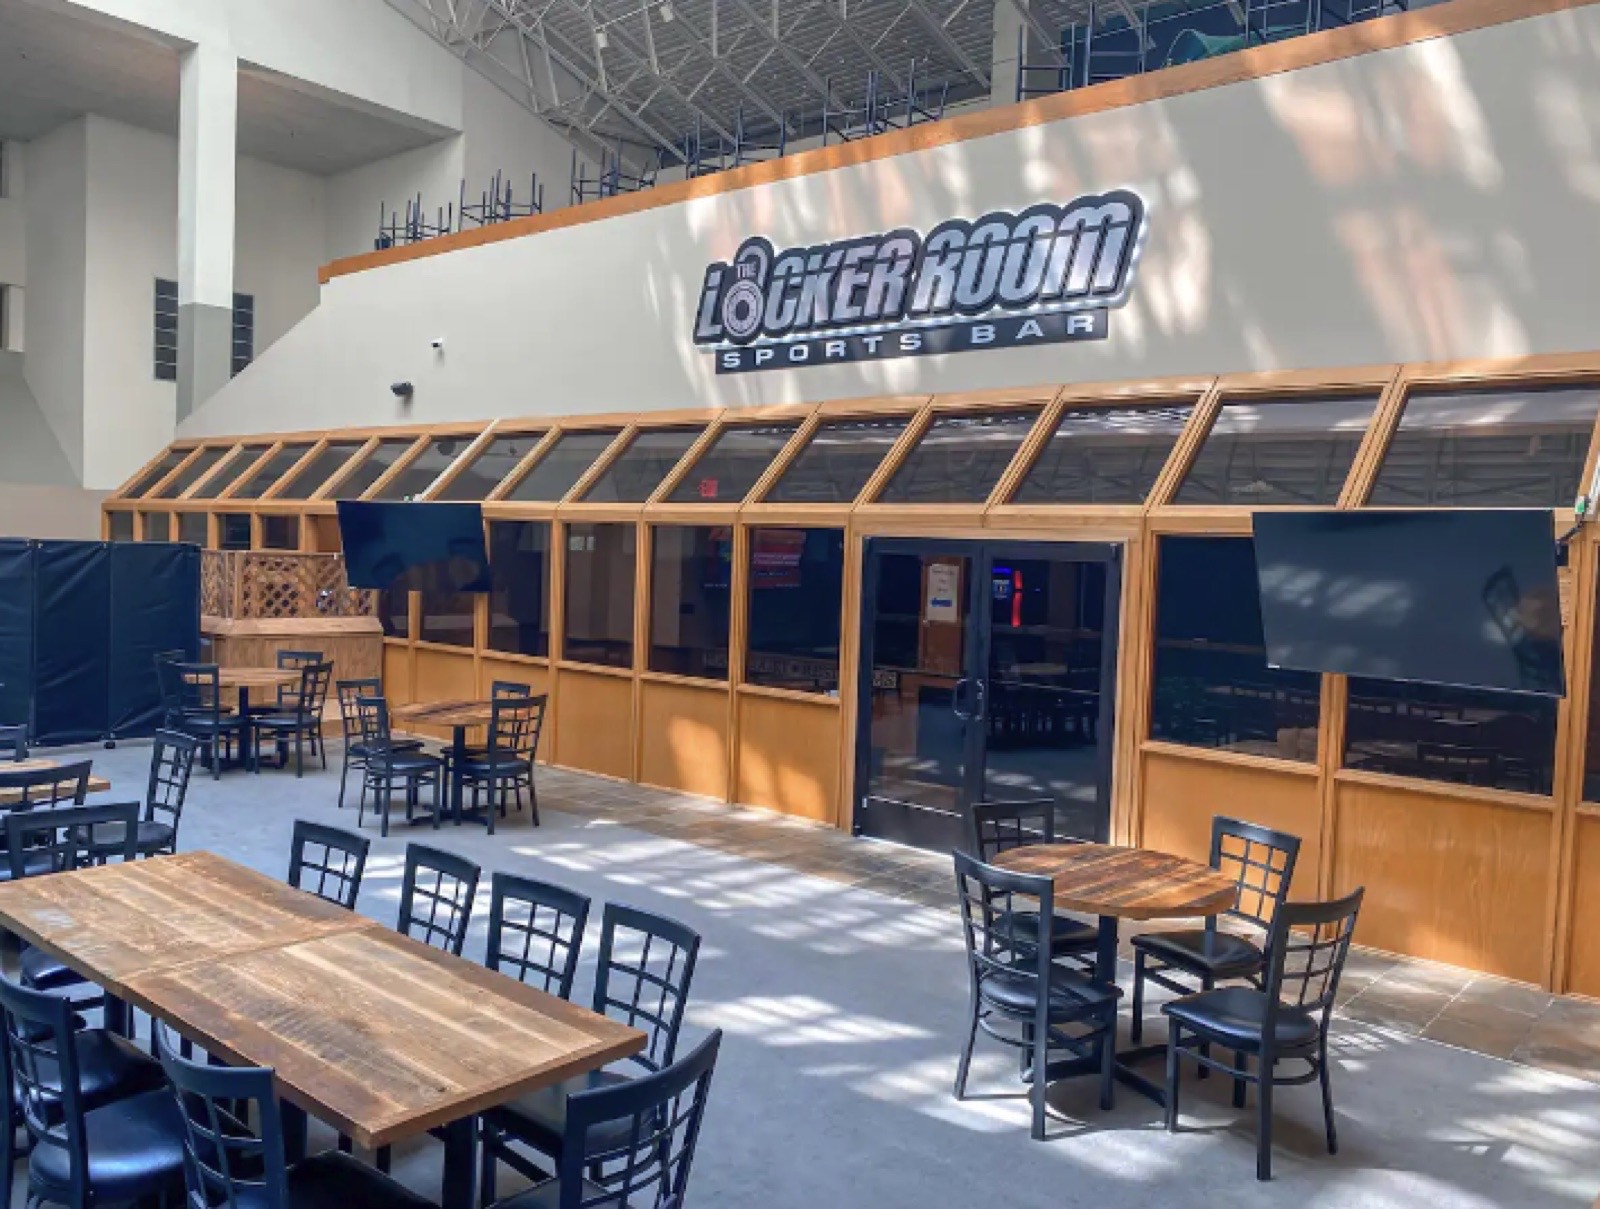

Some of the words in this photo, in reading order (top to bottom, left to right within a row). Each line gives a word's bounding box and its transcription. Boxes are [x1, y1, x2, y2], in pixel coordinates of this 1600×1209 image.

[696, 237, 914, 338] LOCKER
[910, 202, 1131, 311] ROOM
[737, 261, 757, 278] THE
[722, 332, 922, 369] SPORTS
[970, 314, 1096, 344] BAR
